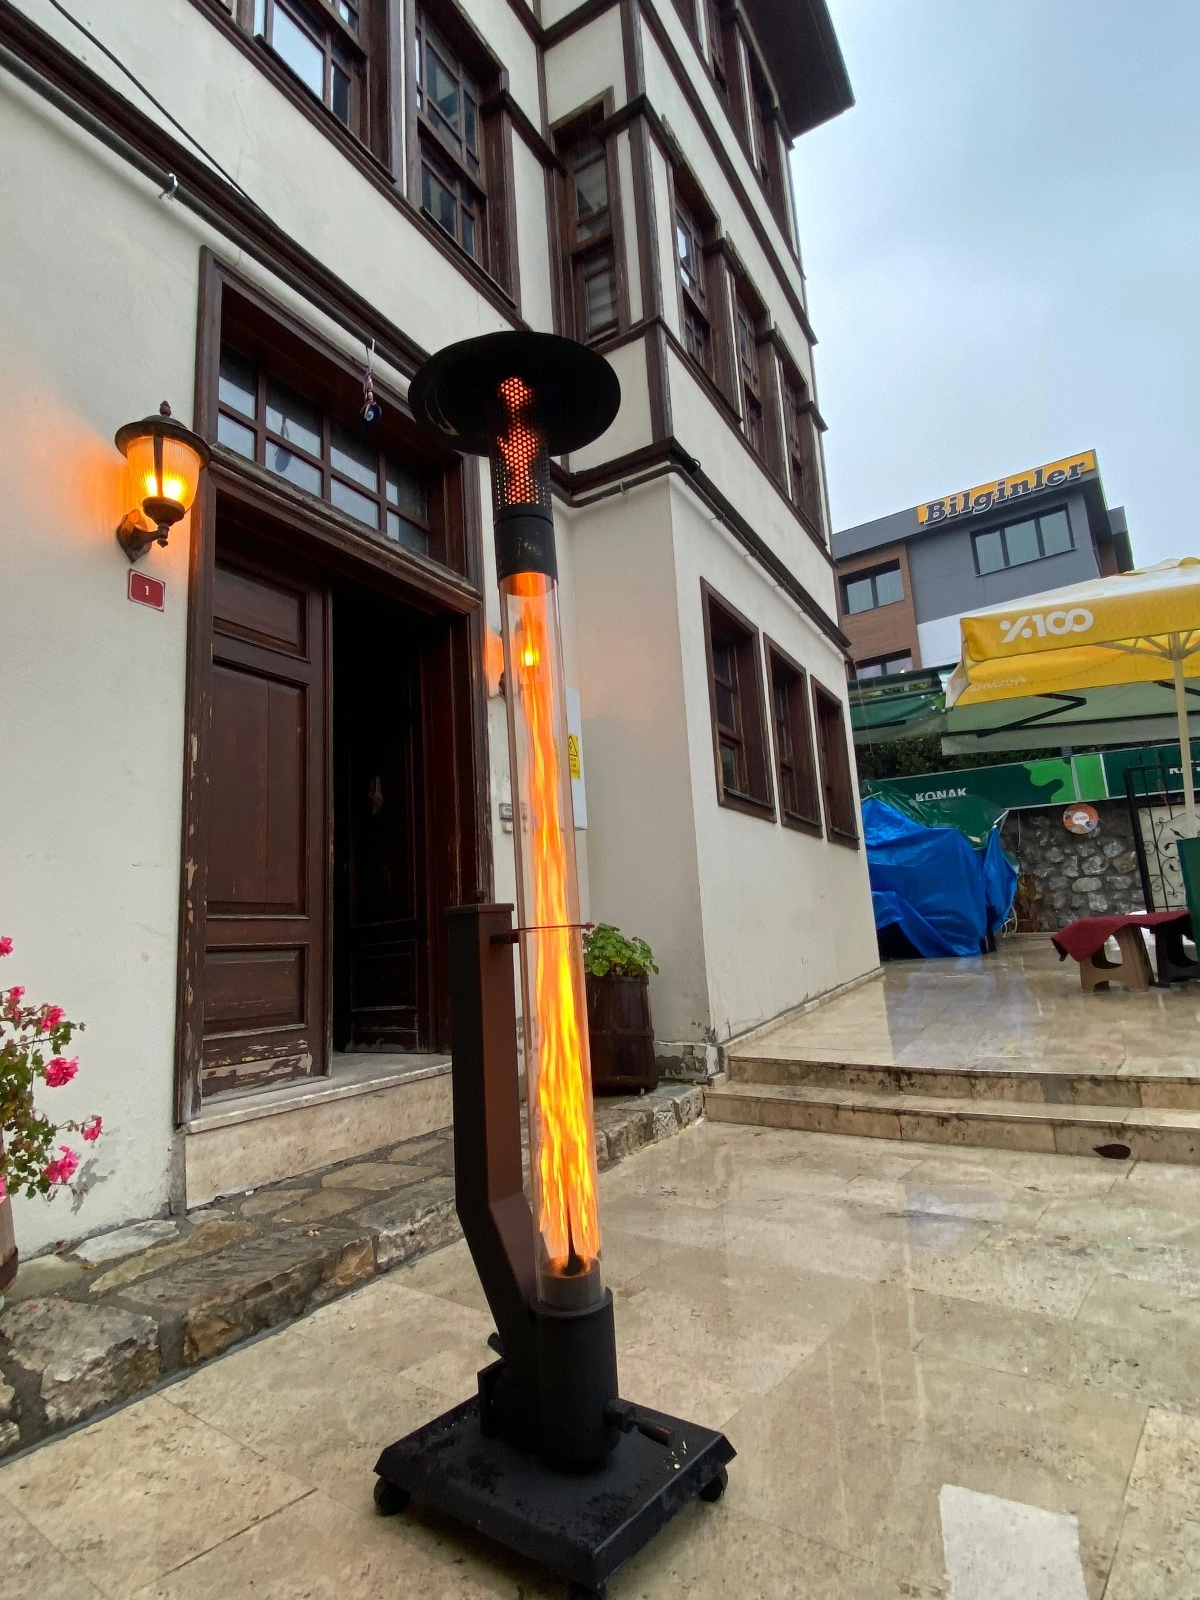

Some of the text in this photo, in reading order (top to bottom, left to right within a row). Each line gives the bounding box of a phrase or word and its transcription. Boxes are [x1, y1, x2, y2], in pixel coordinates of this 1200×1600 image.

[924, 461, 1087, 525] Bilginler
[144, 585, 149, 596] 1
[1000, 608, 1093, 643] %100
[914, 788, 967, 802] KONAK
